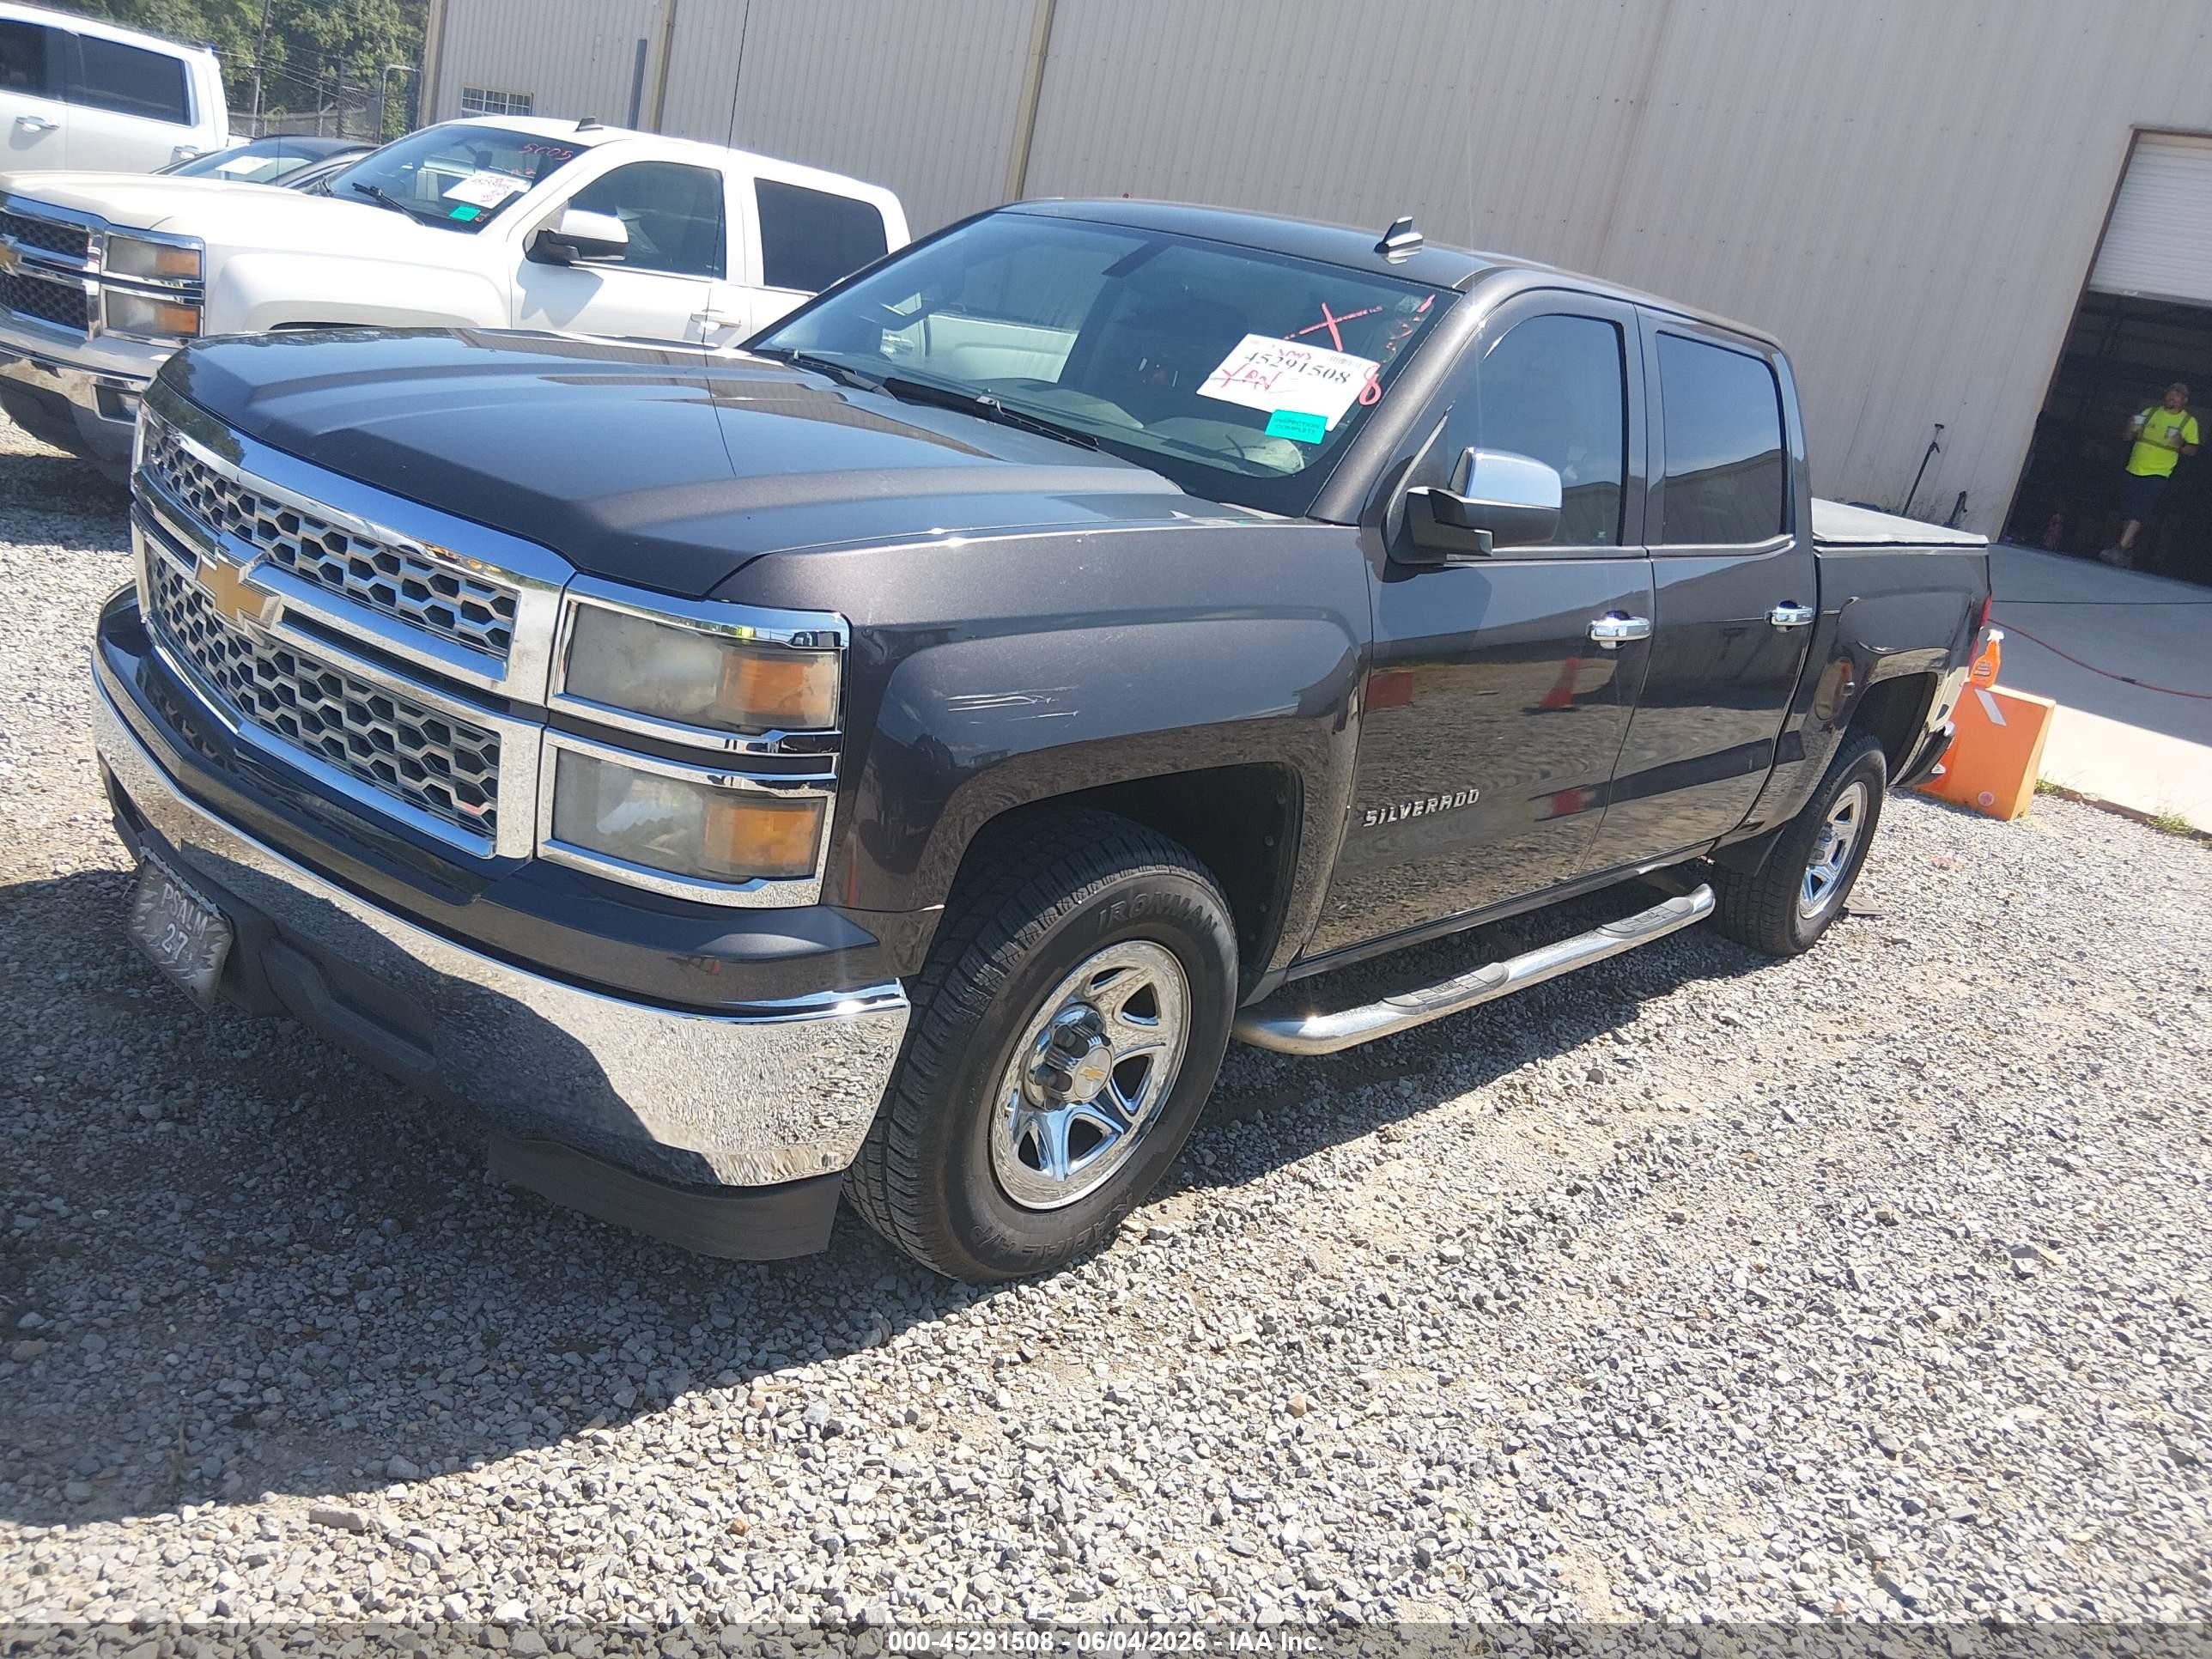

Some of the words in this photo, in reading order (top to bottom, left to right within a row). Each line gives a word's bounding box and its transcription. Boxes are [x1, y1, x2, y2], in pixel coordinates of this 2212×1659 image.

[1244, 351, 1352, 385] 45291508
[1363, 788, 1480, 828] SILVERADO
[160, 882, 209, 940] PSALM
[1097, 892, 1218, 935] IRONMAN
